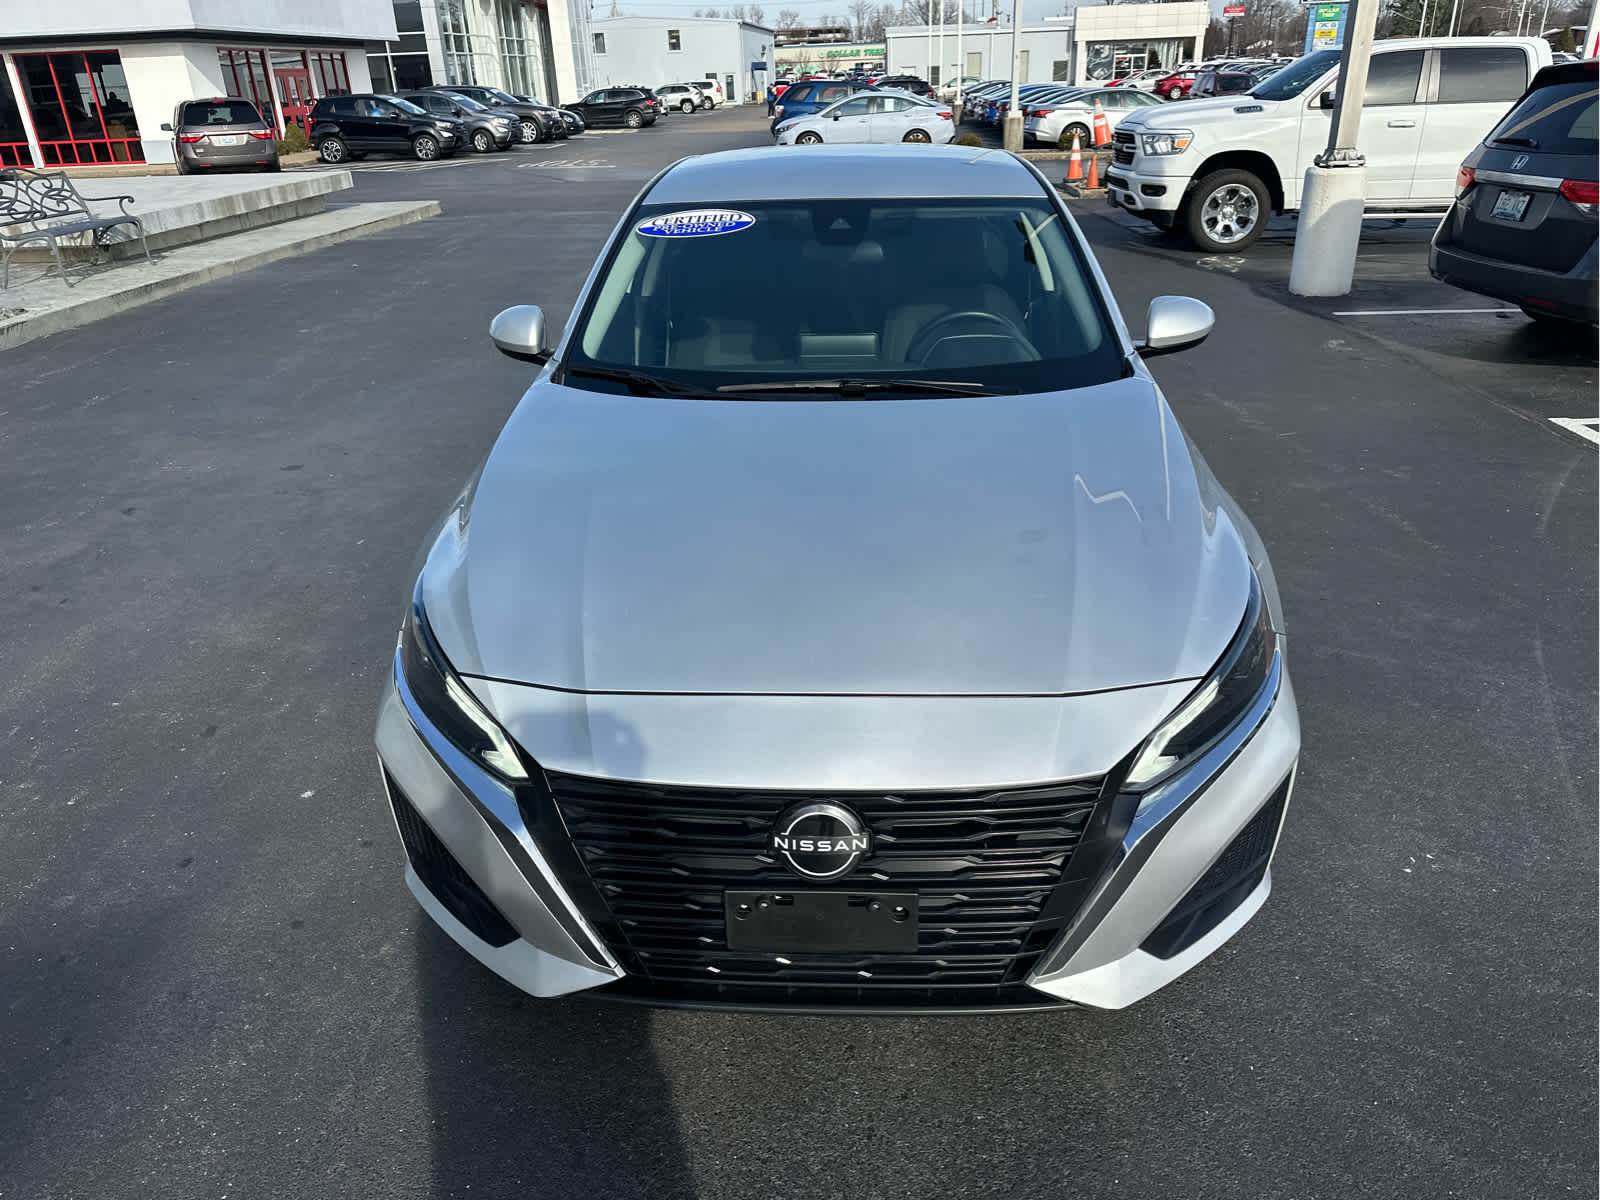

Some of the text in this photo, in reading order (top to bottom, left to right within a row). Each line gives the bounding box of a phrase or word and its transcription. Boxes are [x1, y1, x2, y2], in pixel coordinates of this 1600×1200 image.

[827, 49, 861, 58] DOLLAR
[652, 213, 743, 226] CERTIFIED
[652, 221, 736, 232] PRE-OWNED
[664, 226, 722, 235] VEHICLE
[774, 836, 867, 852] NISSAN
